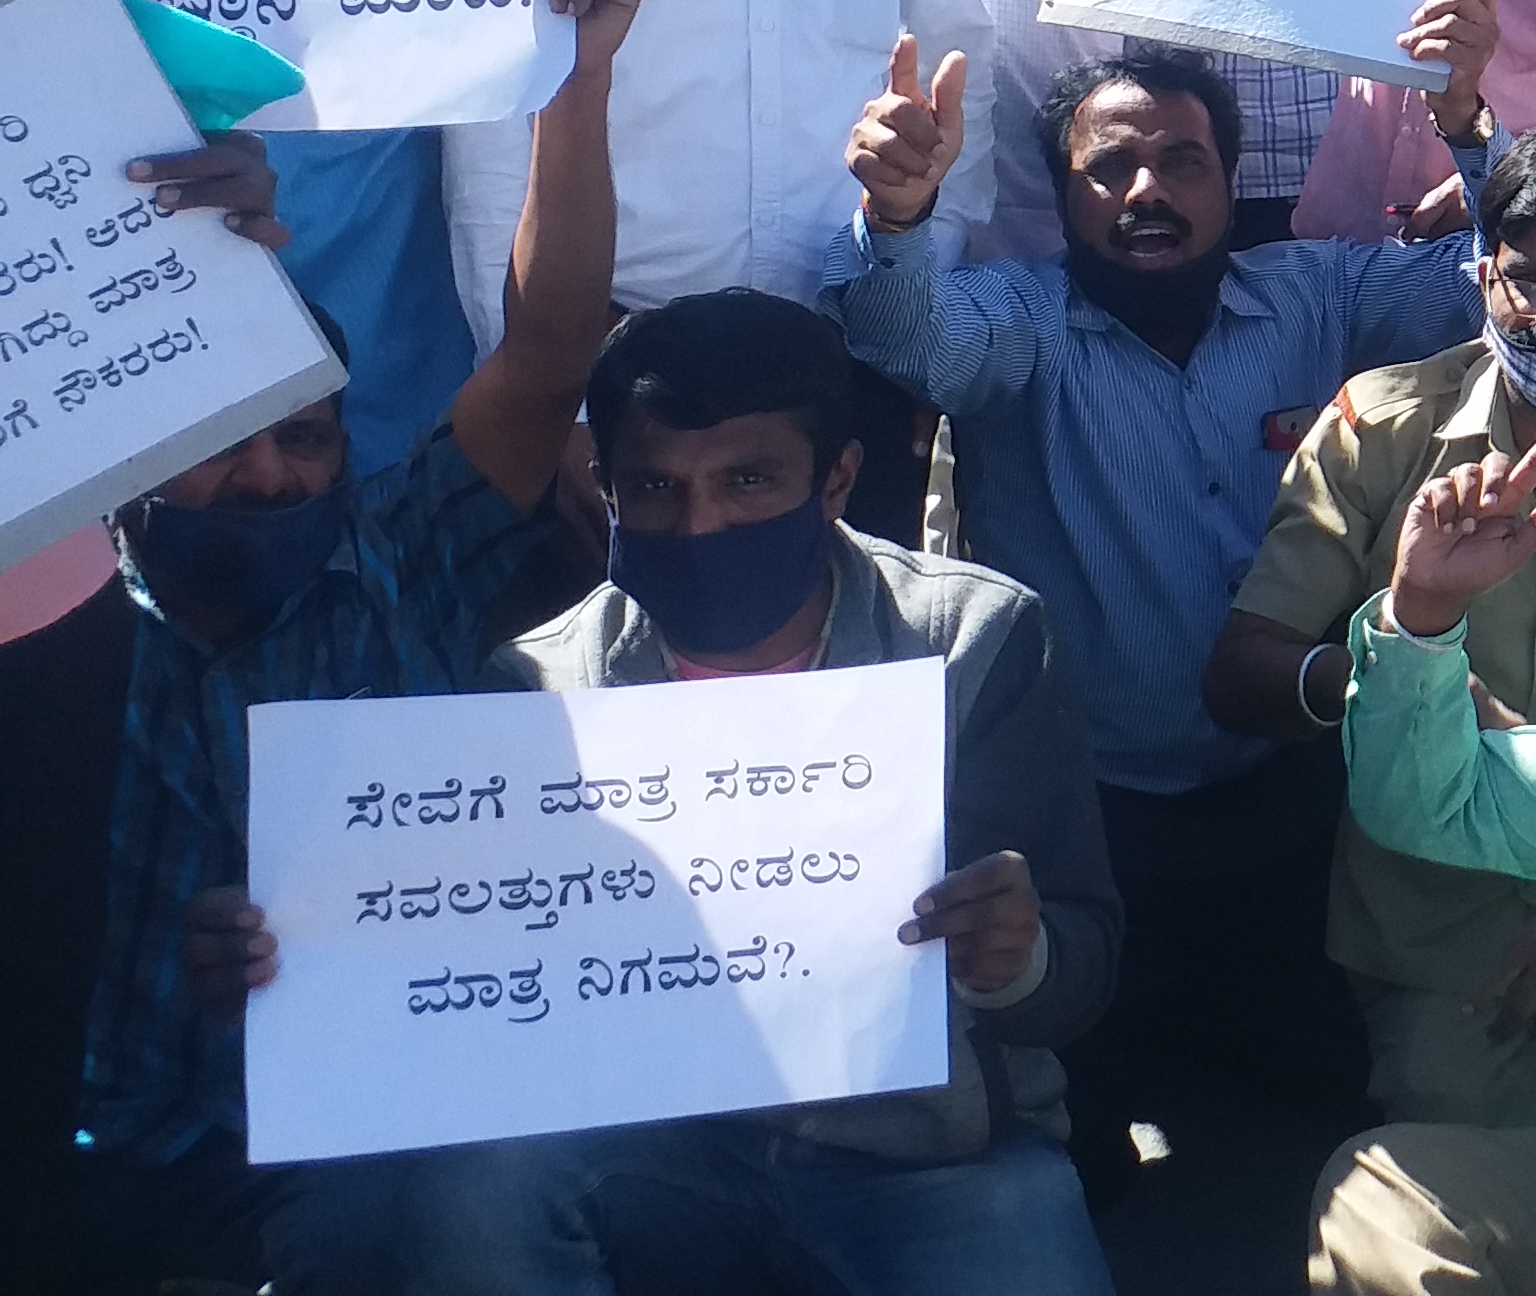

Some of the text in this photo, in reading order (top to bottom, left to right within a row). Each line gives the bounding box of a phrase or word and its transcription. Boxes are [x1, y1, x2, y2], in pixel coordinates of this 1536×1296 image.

[88, 247, 197, 314] ಮಾತ್ರ
[53, 317, 209, 412] ನೌಕರರು!
[346, 753, 873, 829] ಸೇವೆಗೆ ಮಾತ್ರ ಸರ್ಕಾರಿ
[356, 845, 861, 932] ಸವಲತ್ತುಗಳು ನೀಡಲು
[407, 934, 812, 1024] ಮಾತ್ರ ನಿಗಮವೆ?.
